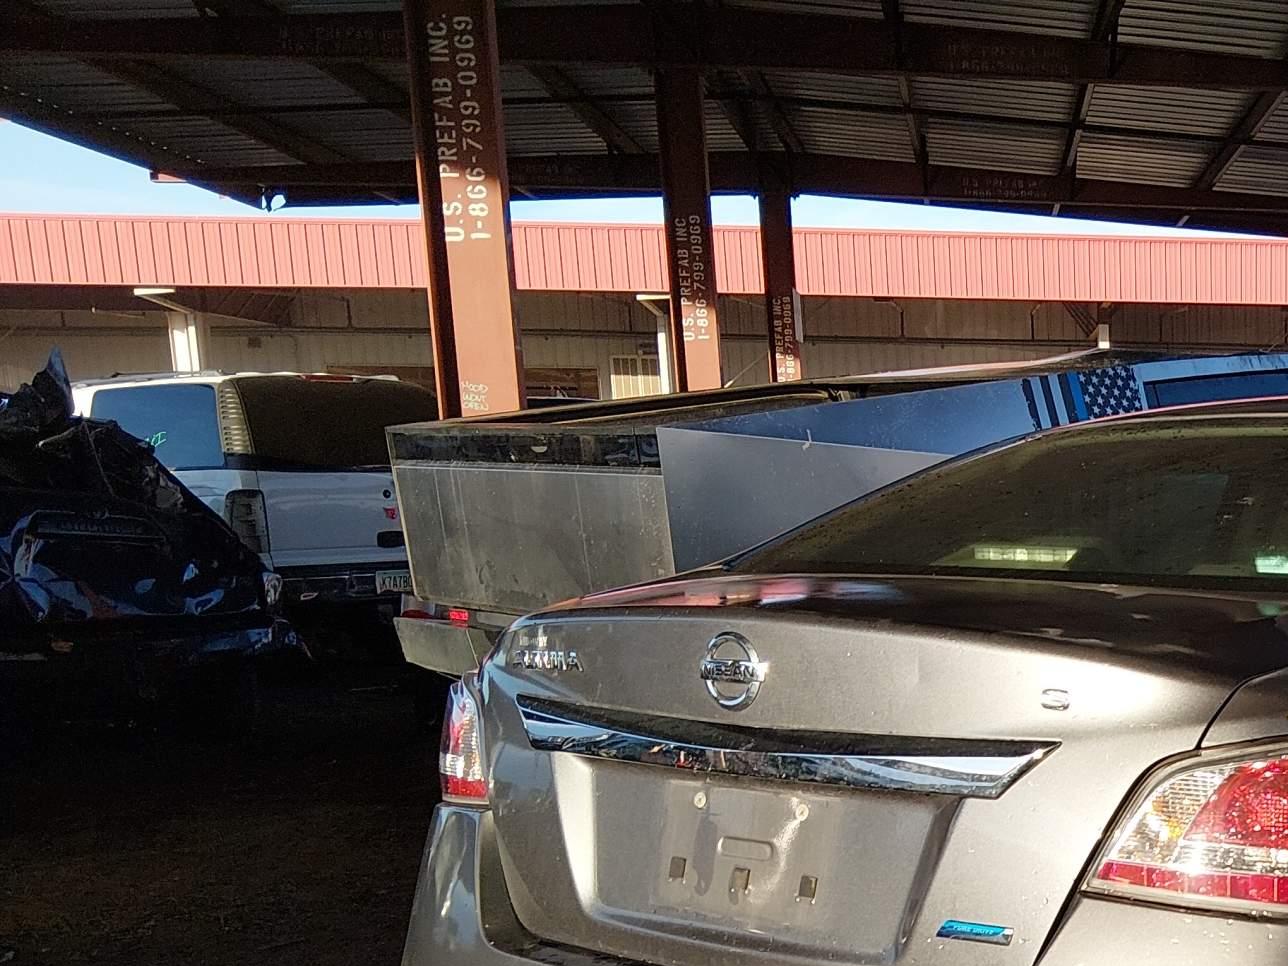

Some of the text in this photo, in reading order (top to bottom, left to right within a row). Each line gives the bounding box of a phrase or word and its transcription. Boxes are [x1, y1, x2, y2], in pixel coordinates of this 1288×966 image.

[426, 13, 465, 243] U.S. PREFAB INC.
[452, 15, 492, 241] 1-866-799-0969
[676, 249, 694, 306] PREFAB
[688, 214, 711, 341] 1-866-799-0969
[682, 313, 696, 341] U.S.
[773, 320, 786, 359] PREFAB
[512, 649, 584, 672] ALTIMA
[702, 663, 755, 679] NISSAN
